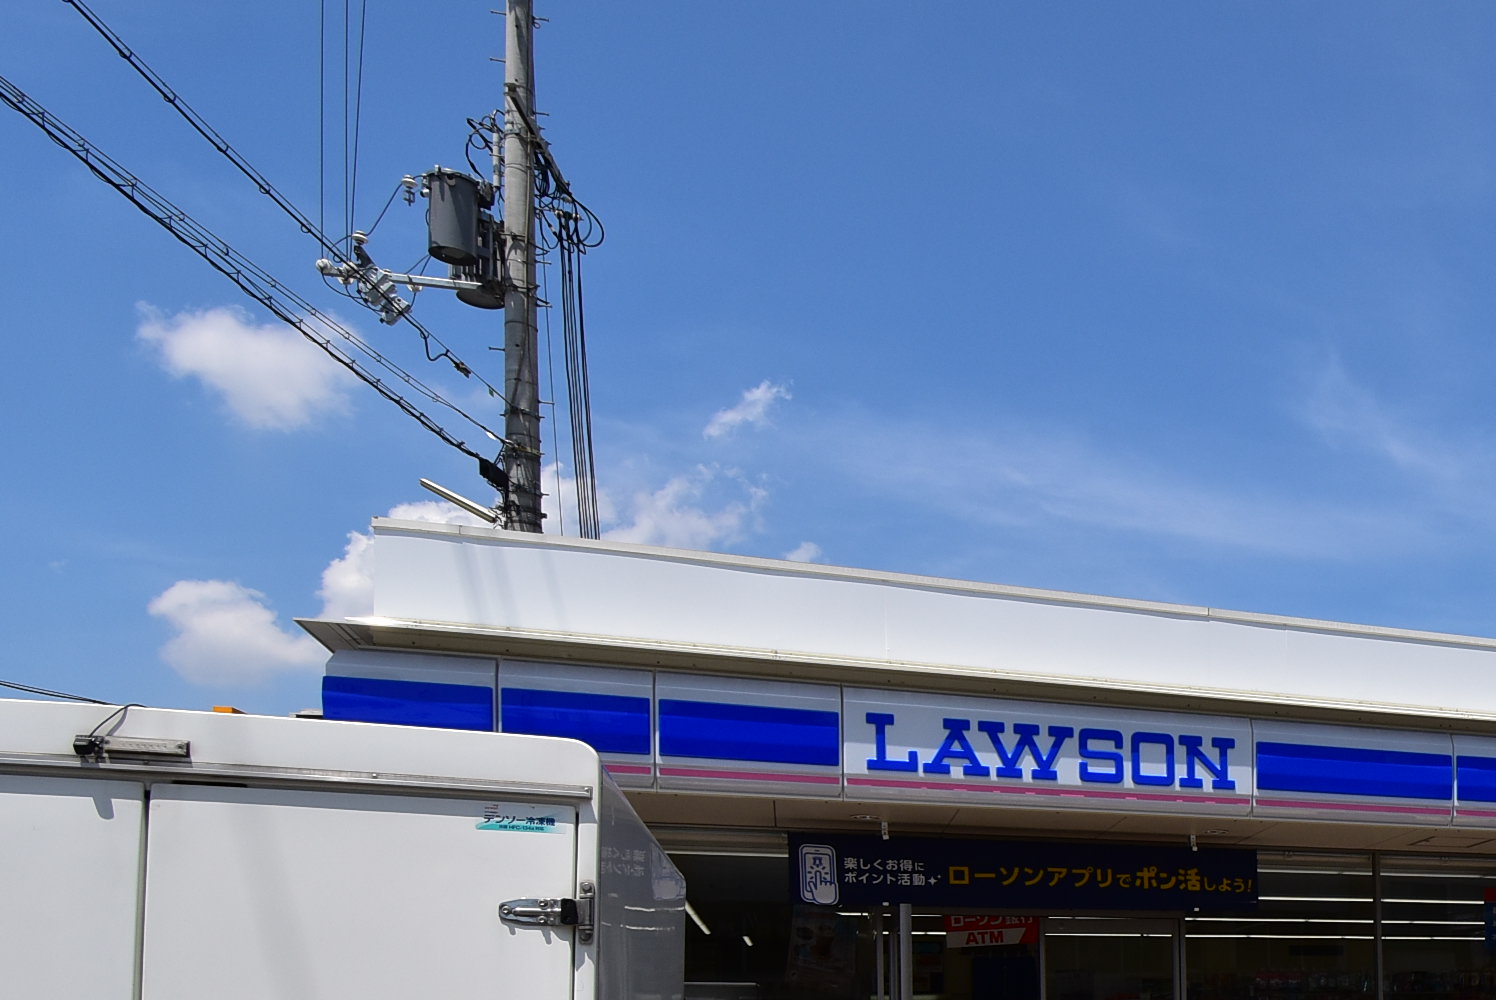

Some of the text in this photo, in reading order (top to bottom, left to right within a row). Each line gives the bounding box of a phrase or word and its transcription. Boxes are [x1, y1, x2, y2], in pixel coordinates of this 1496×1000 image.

[865, 711, 1236, 791] LAWSON
[483, 814, 556, 827] デンソー冷凍機
[843, 857, 926, 872] 楽しくお得に
[843, 871, 926, 886] ポイント活動
[947, 864, 1254, 893] ローソンアプリでポン活しよう!
[965, 930, 1004, 945] ATM
